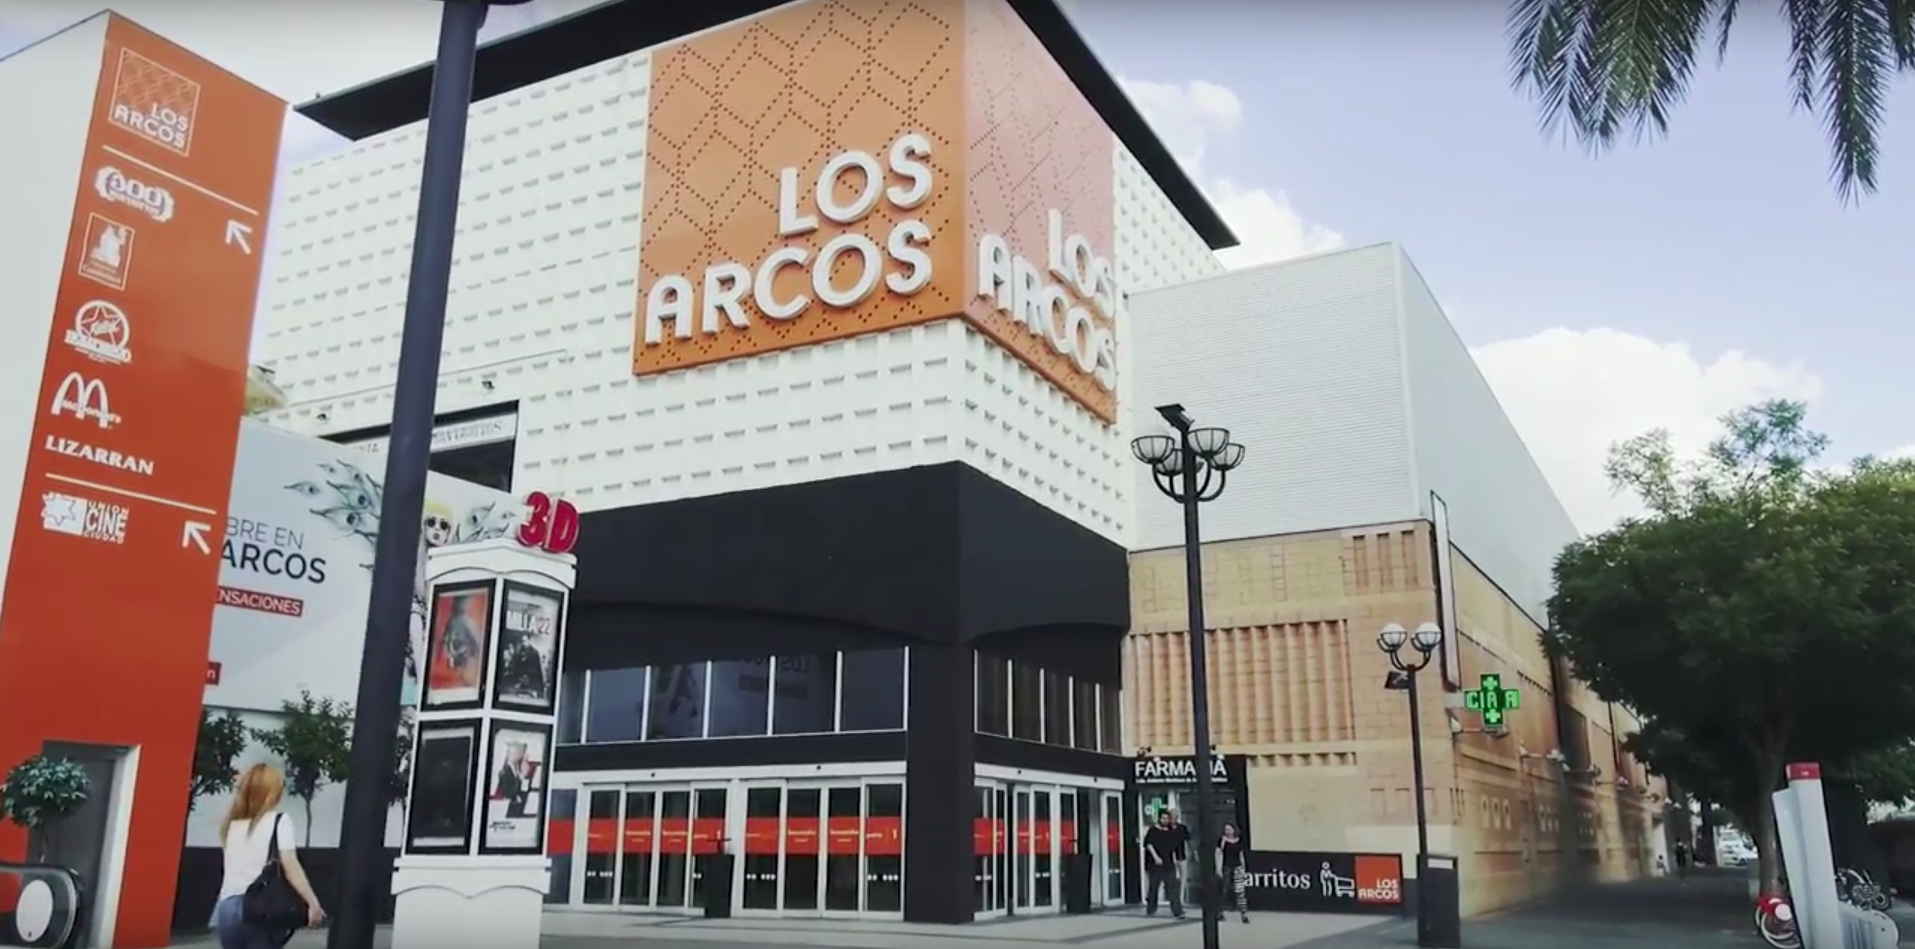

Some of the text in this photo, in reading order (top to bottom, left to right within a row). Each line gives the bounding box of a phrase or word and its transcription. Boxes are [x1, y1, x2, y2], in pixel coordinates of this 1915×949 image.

[114, 104, 186, 149] ARCOS
[151, 102, 188, 132] LOS
[778, 133, 932, 238] LOS
[644, 219, 932, 346] ARCOS
[1048, 208, 1114, 320] LOS
[977, 233, 1116, 392] ARCOS
[45, 434, 154, 476] LIZARRAN
[86, 508, 127, 536] CINE
[226, 516, 304, 549] BRE EN
[518, 490, 580, 552] 3D
[221, 539, 326, 584] ARCOS
[218, 588, 301, 615] NSACIONES
[1135, 760, 1227, 778] FARMAIA
[1244, 867, 1311, 890] arritos
[1358, 887, 1399, 900] ARCOS
[1376, 877, 1399, 890] LOS
